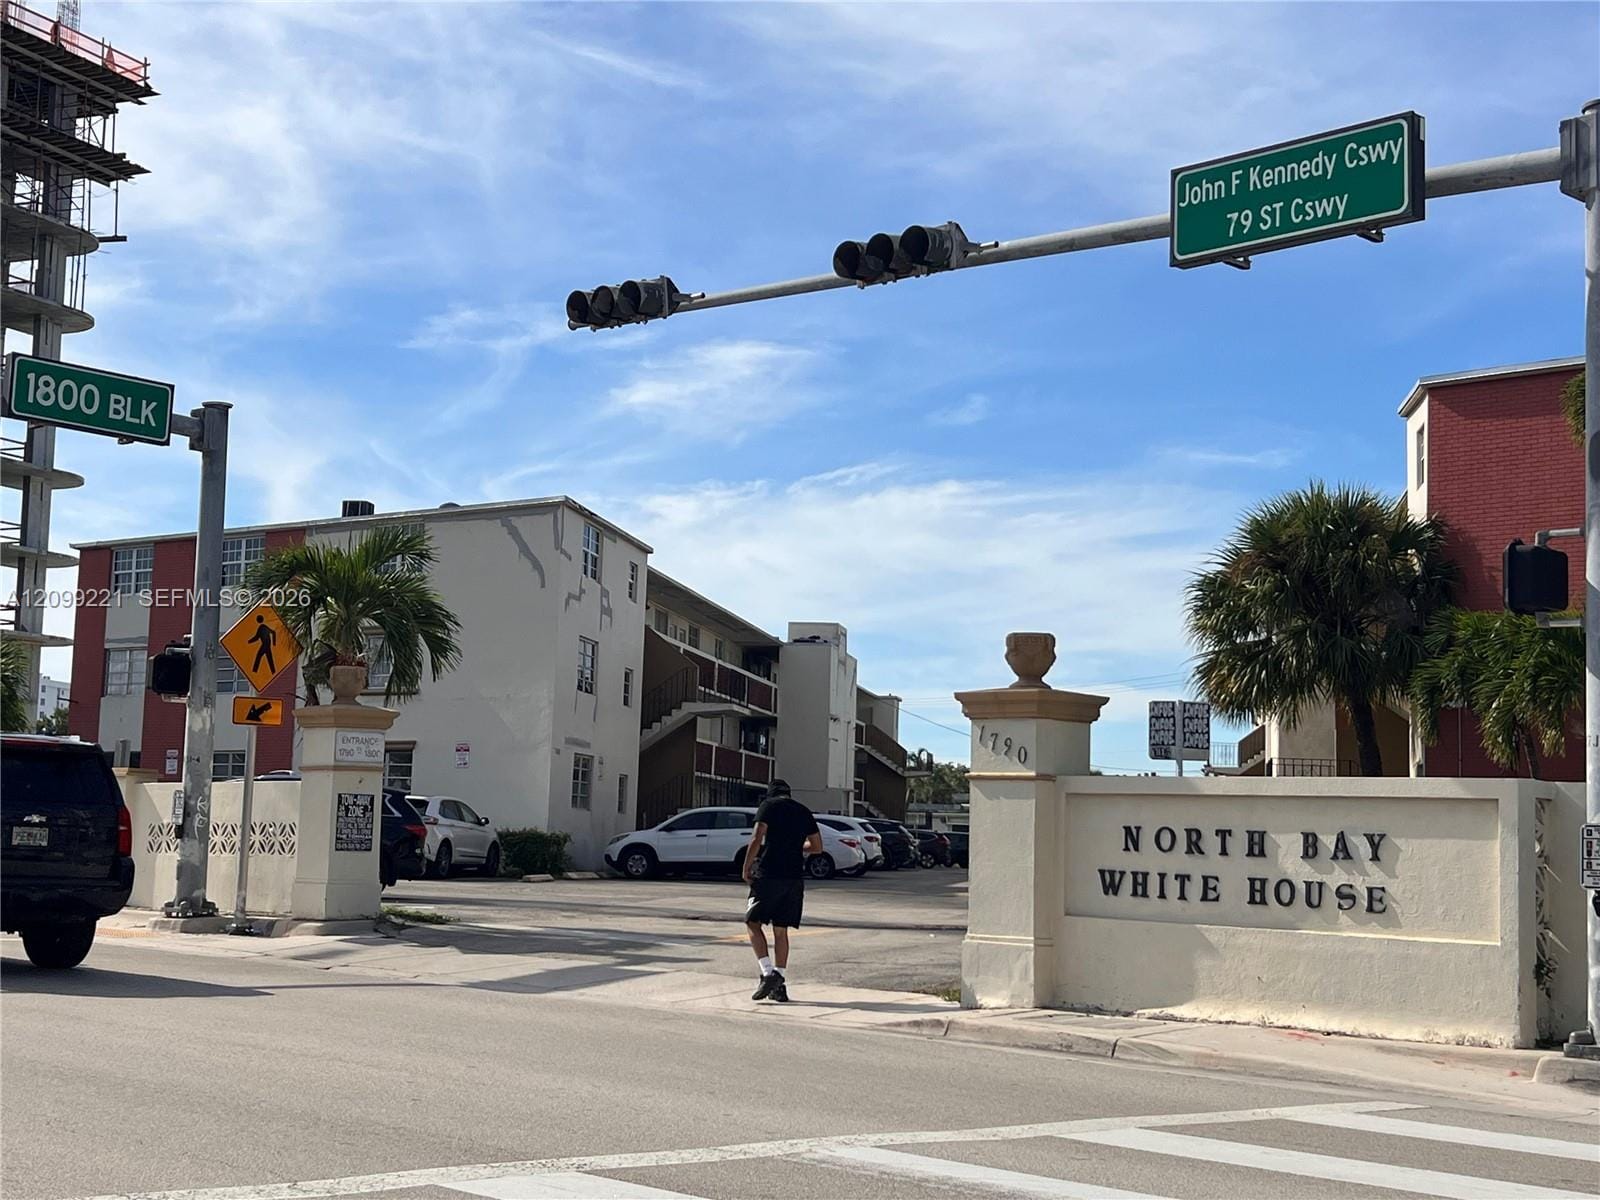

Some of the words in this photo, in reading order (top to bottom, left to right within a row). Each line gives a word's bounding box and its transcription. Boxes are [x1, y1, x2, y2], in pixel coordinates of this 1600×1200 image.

[1179, 179, 1225, 207] John
[1231, 170, 1243, 195] F
[1249, 151, 1337, 192] Kennedy
[1344, 137, 1403, 169] Cswy
[1227, 210, 1252, 237] 79
[1259, 203, 1283, 231] ST
[1290, 194, 1348, 224] Cswy
[27, 372, 99, 415] 1800
[108, 393, 157, 427] BLK
[341, 735, 382, 746] ENTRANCE
[979, 725, 1028, 764] 1790
[347, 805, 364, 817] ZONE
[1122, 825, 1268, 858] NORTH
[1300, 830, 1387, 861] BAY
[1097, 868, 1221, 902] WHITE
[1247, 876, 1388, 914] HOUSE
